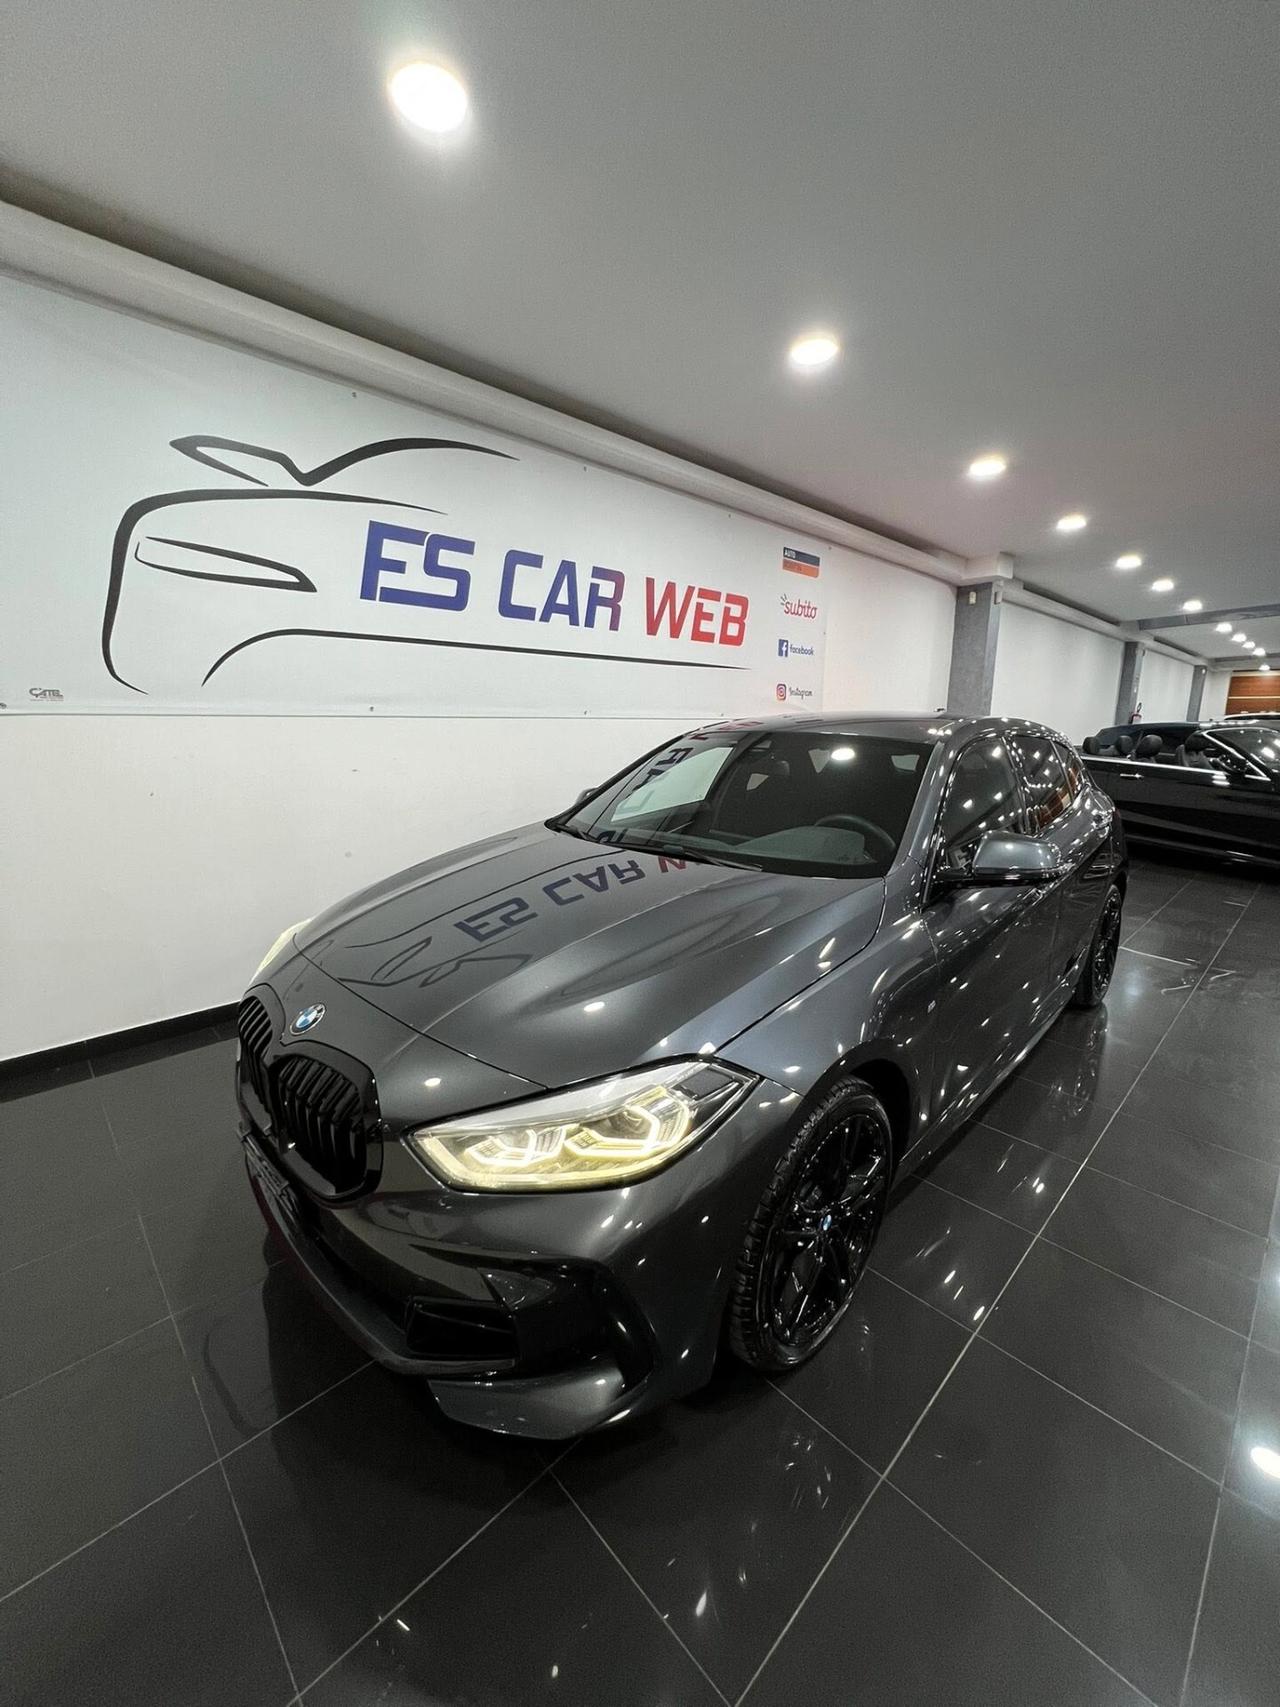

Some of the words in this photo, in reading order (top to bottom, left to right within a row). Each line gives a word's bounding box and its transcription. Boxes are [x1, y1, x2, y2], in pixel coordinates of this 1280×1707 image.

[360, 520, 476, 612] ES
[498, 549, 626, 631] CAR
[645, 577, 750, 647] WEB
[784, 599, 818, 619] subito
[789, 644, 814, 656] facebook
